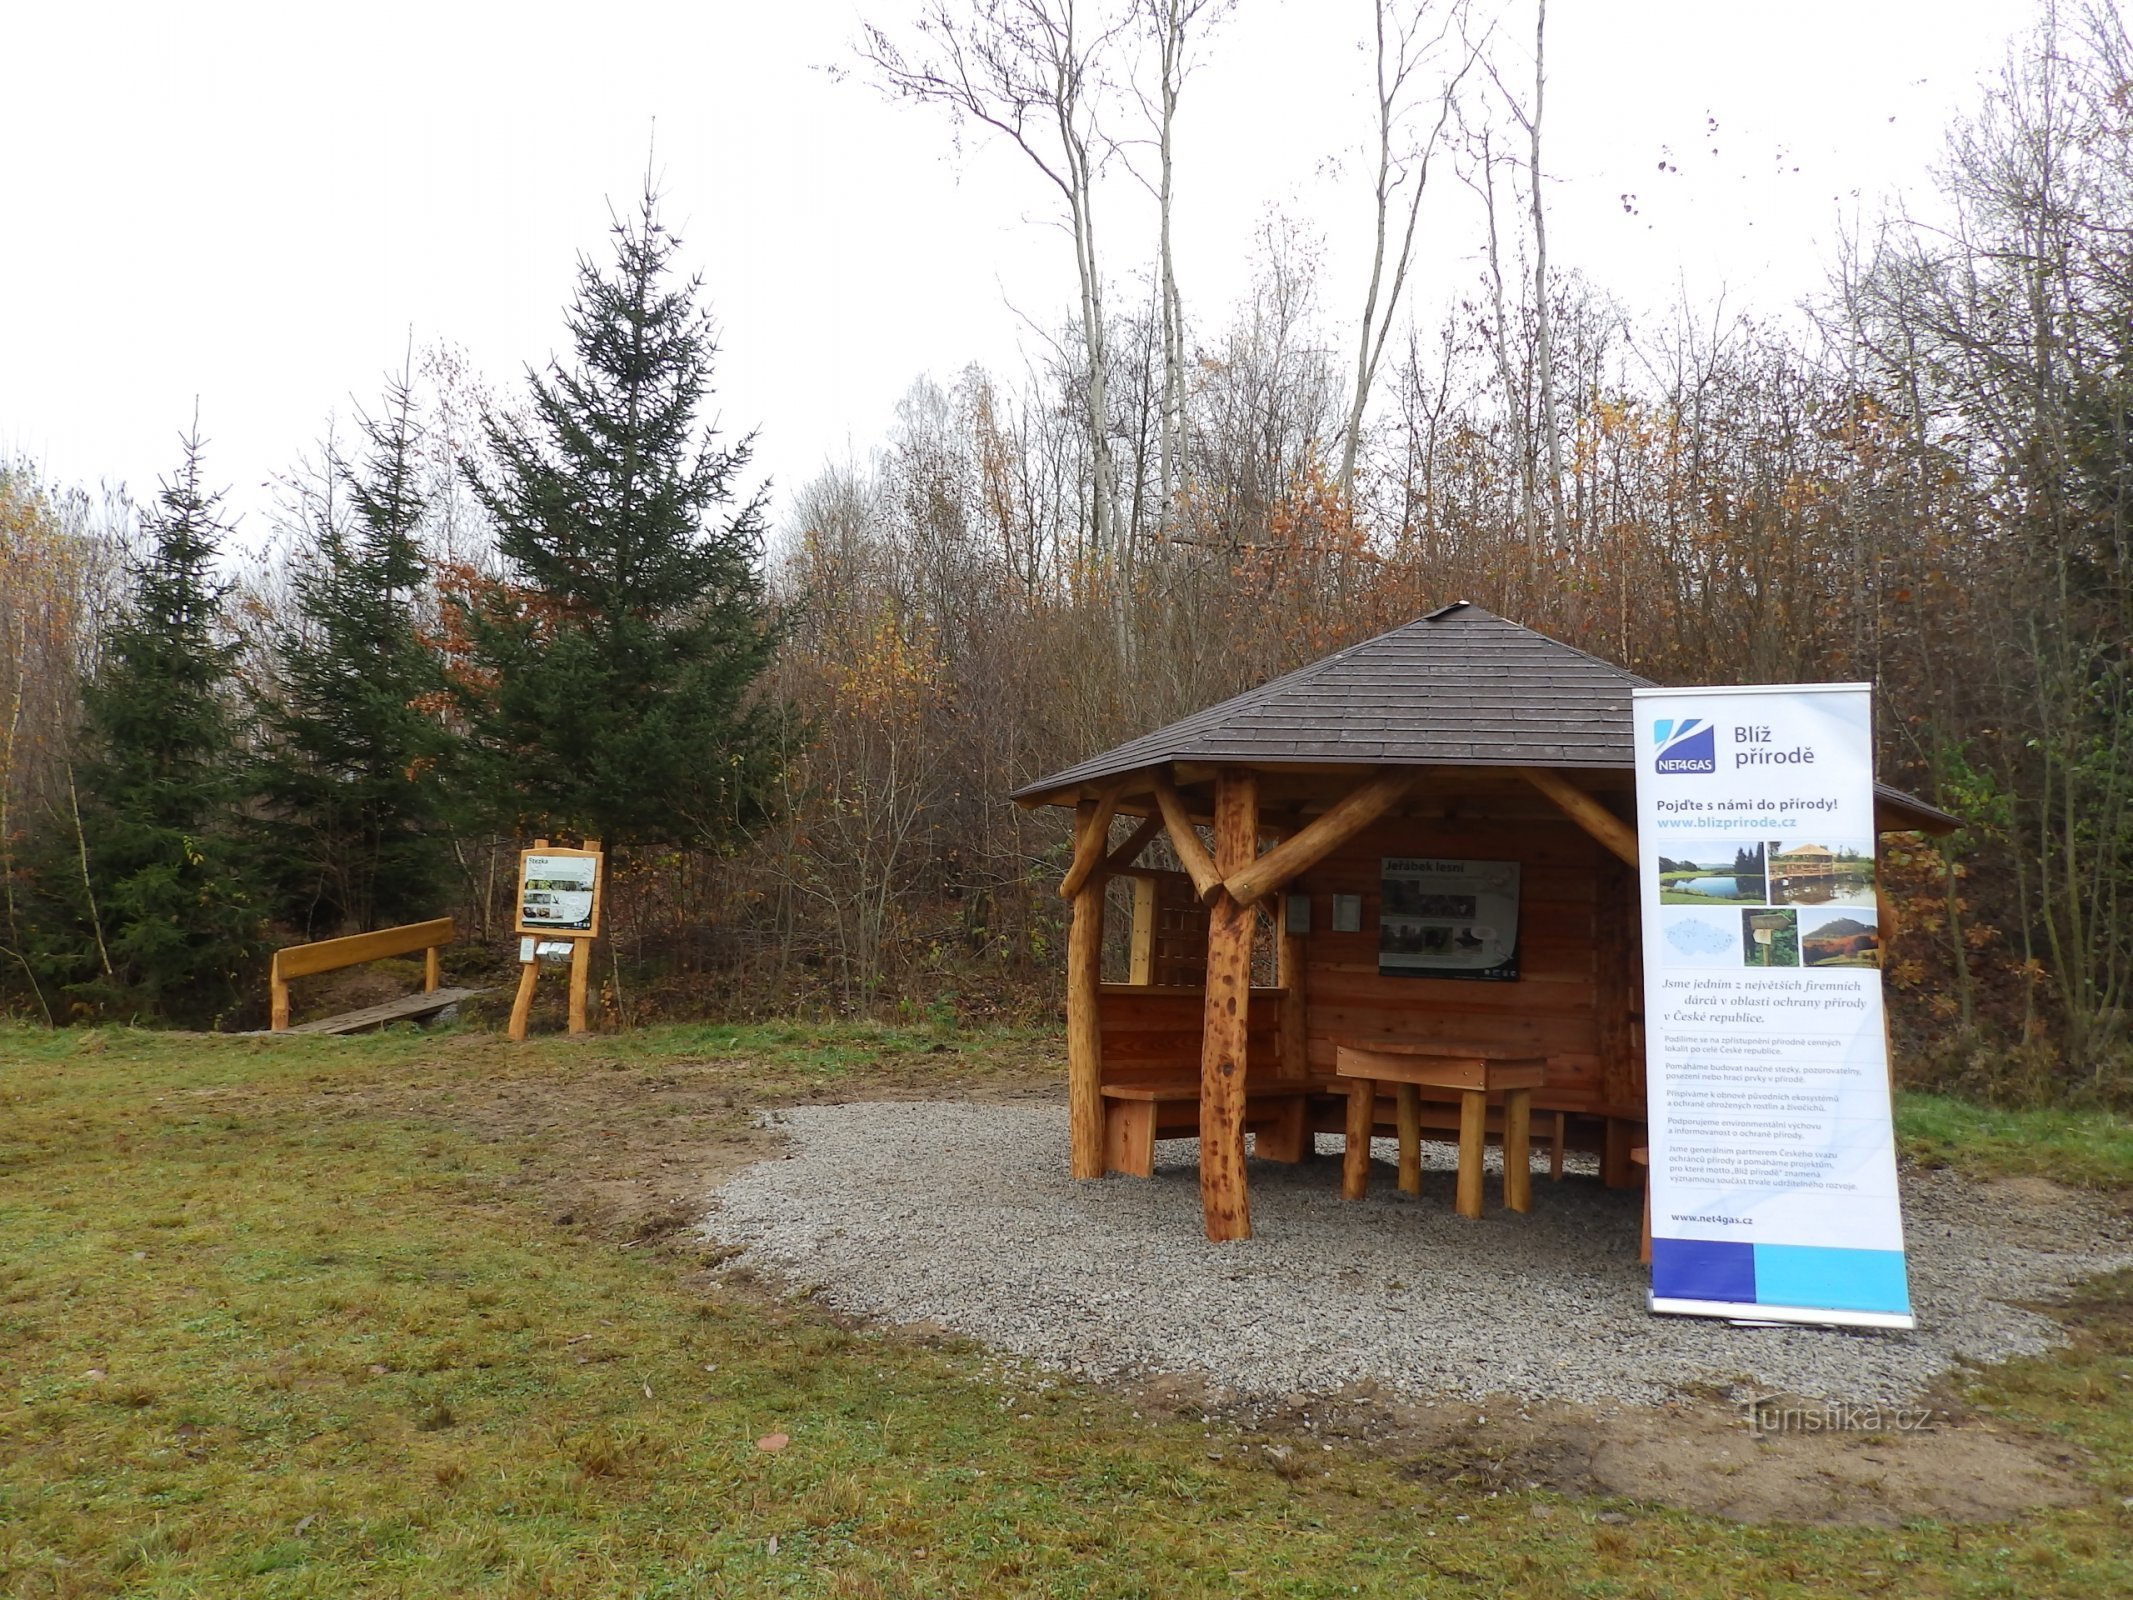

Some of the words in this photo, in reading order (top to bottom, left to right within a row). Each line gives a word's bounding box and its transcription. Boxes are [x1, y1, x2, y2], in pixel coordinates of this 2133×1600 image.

[1735, 726, 1772, 743] Blíž
[1736, 747, 1814, 769] přírodě
[1658, 759, 1712, 771] NET4GAS
[1657, 799, 1703, 813] Pojďte
[1707, 803, 1713, 811] s
[1717, 799, 1753, 811] námi
[1757, 799, 1775, 811] do
[1780, 798, 1838, 813] přírody!
[1657, 817, 1797, 830] www.blizprirode.cz
[1385, 861, 1433, 872] Jeřábek
[1436, 861, 1464, 872] lesní
[1662, 979, 1690, 988] Jsme
[1694, 979, 1731, 990] jedním
[1745, 980, 1802, 991] největších
[1804, 980, 1861, 992] firemních
[1684, 995, 1717, 1005] dárců
[1730, 996, 1770, 1006] oblasti
[1773, 996, 1821, 1009] ochrany
[1824, 998, 1867, 1010] přírody
[1673, 1010, 1706, 1023] České
[1709, 1012, 1764, 1024] republice.
[1671, 1215, 1753, 1225] www.net4gas.cz
